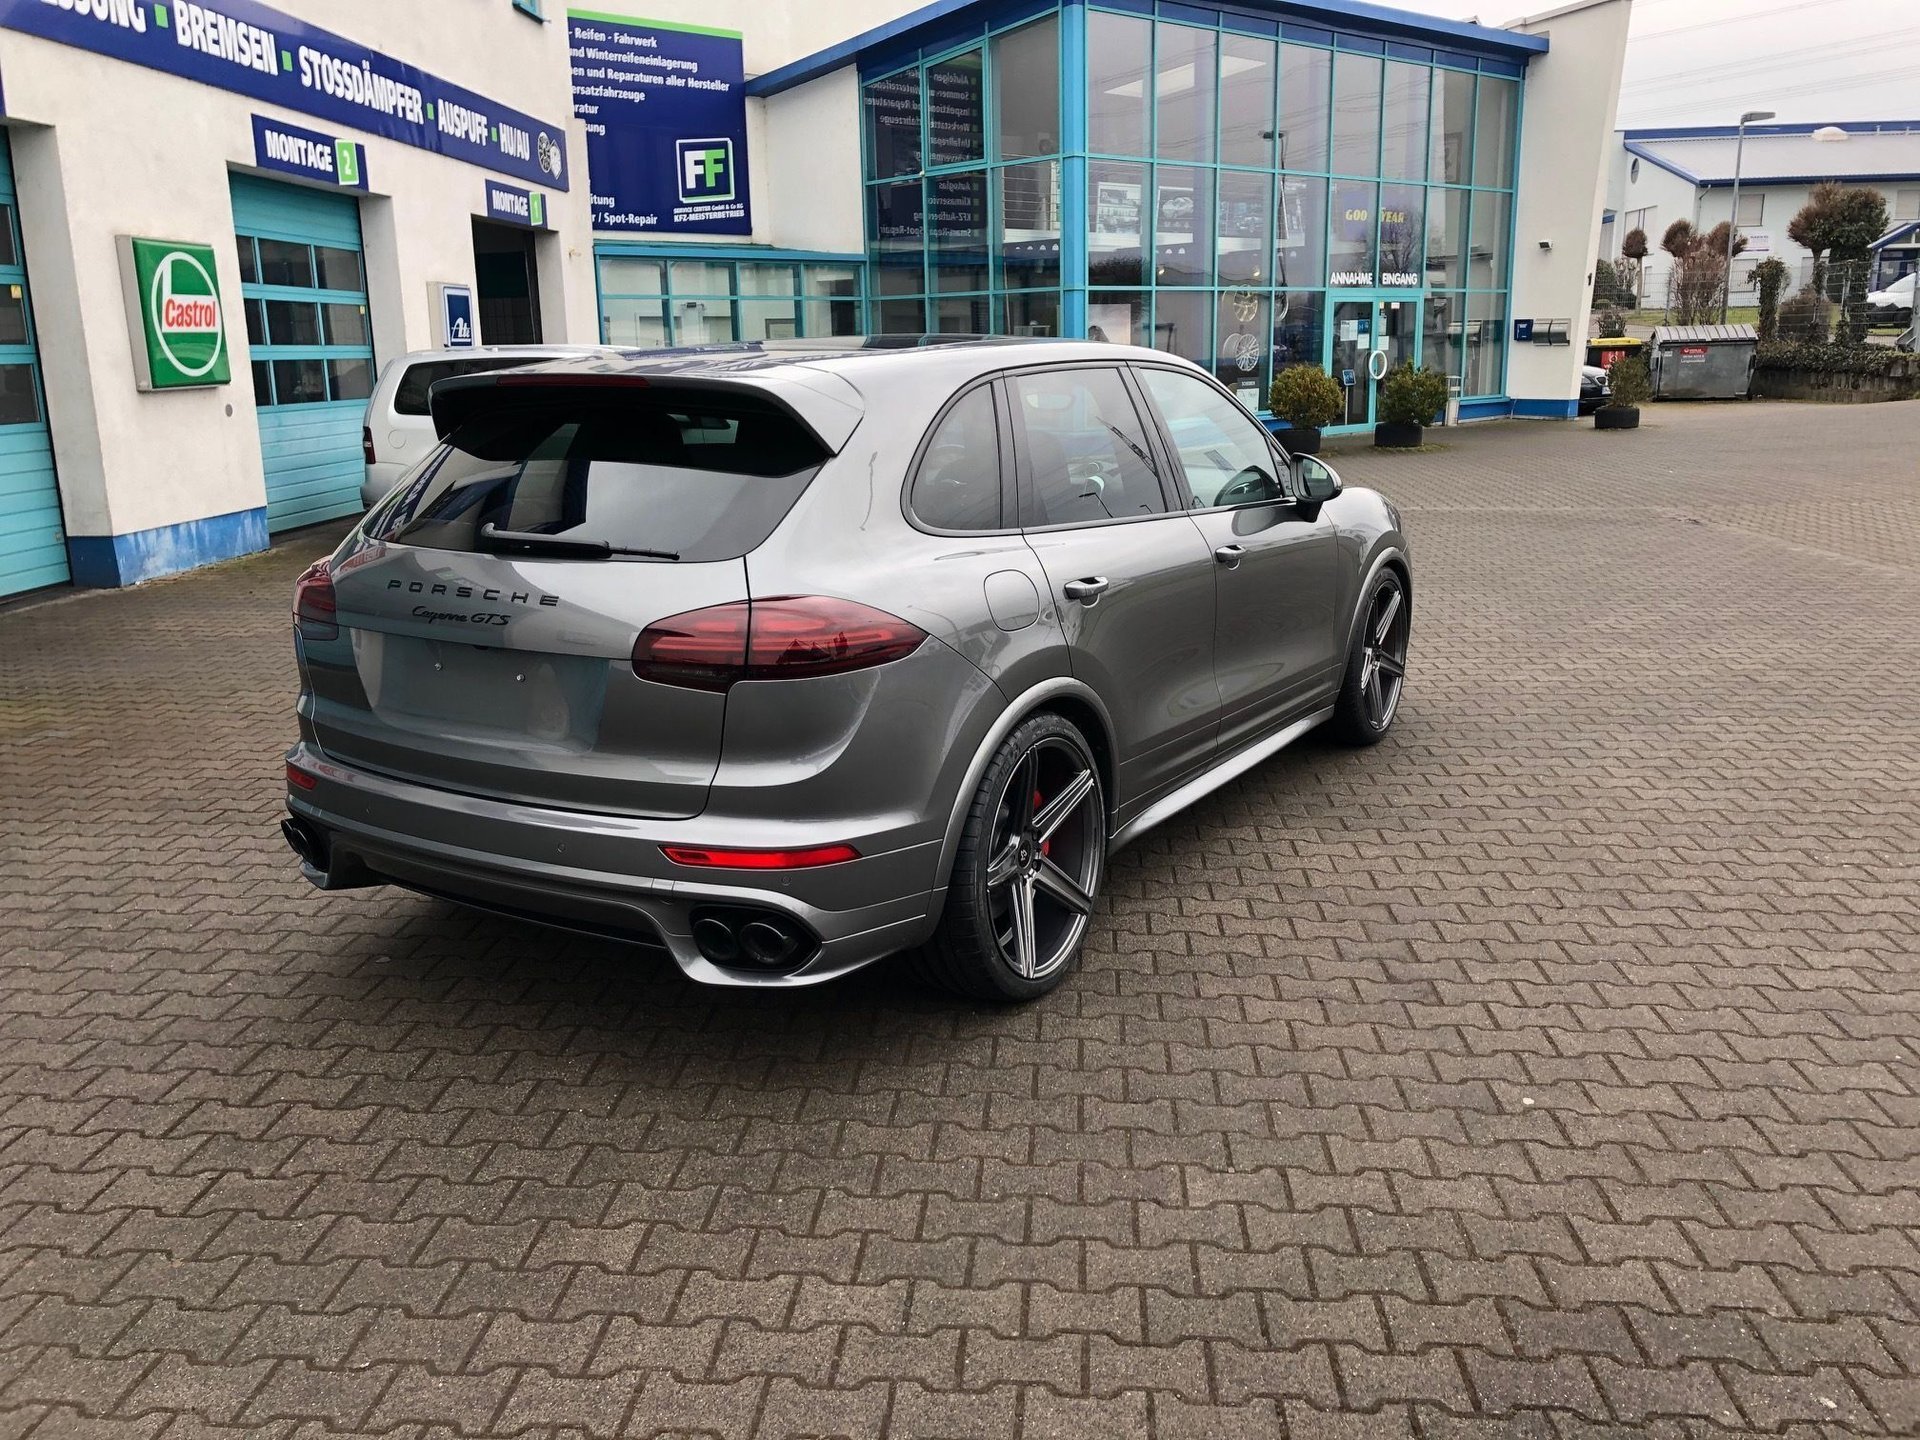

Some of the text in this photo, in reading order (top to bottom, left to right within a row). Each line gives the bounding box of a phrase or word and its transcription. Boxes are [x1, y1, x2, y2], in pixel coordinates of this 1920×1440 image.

[574, 27, 606, 42] Reifen
[613, 32, 658, 48] Fahrwerk
[586, 47, 698, 73] Winterreifeneinlagerung
[173, 0, 279, 76] BREMSEN
[298, 45, 424, 125] STOSSDÄMPFER
[437, 99, 489, 146] AUSPUFF
[498, 122, 530, 161] HU/AU
[572, 67, 730, 92] en und Reparaturen aller Hersteller
[574, 103, 599, 114] ratur
[586, 123, 605, 136] ung
[265, 129, 352, 175] MONTAGE 2
[684, 149, 726, 189] FF
[492, 189, 539, 218] MONTAGE 1
[673, 209, 745, 223] KFZ-MEISTERBETRIEB
[604, 212, 658, 227] Spot-Repair
[1330, 272, 1418, 285] ANNAHME EINGANG
[165, 298, 216, 328] Castrol
[387, 579, 560, 607] PORSCHE
[412, 605, 512, 626] Cayenne GTS
